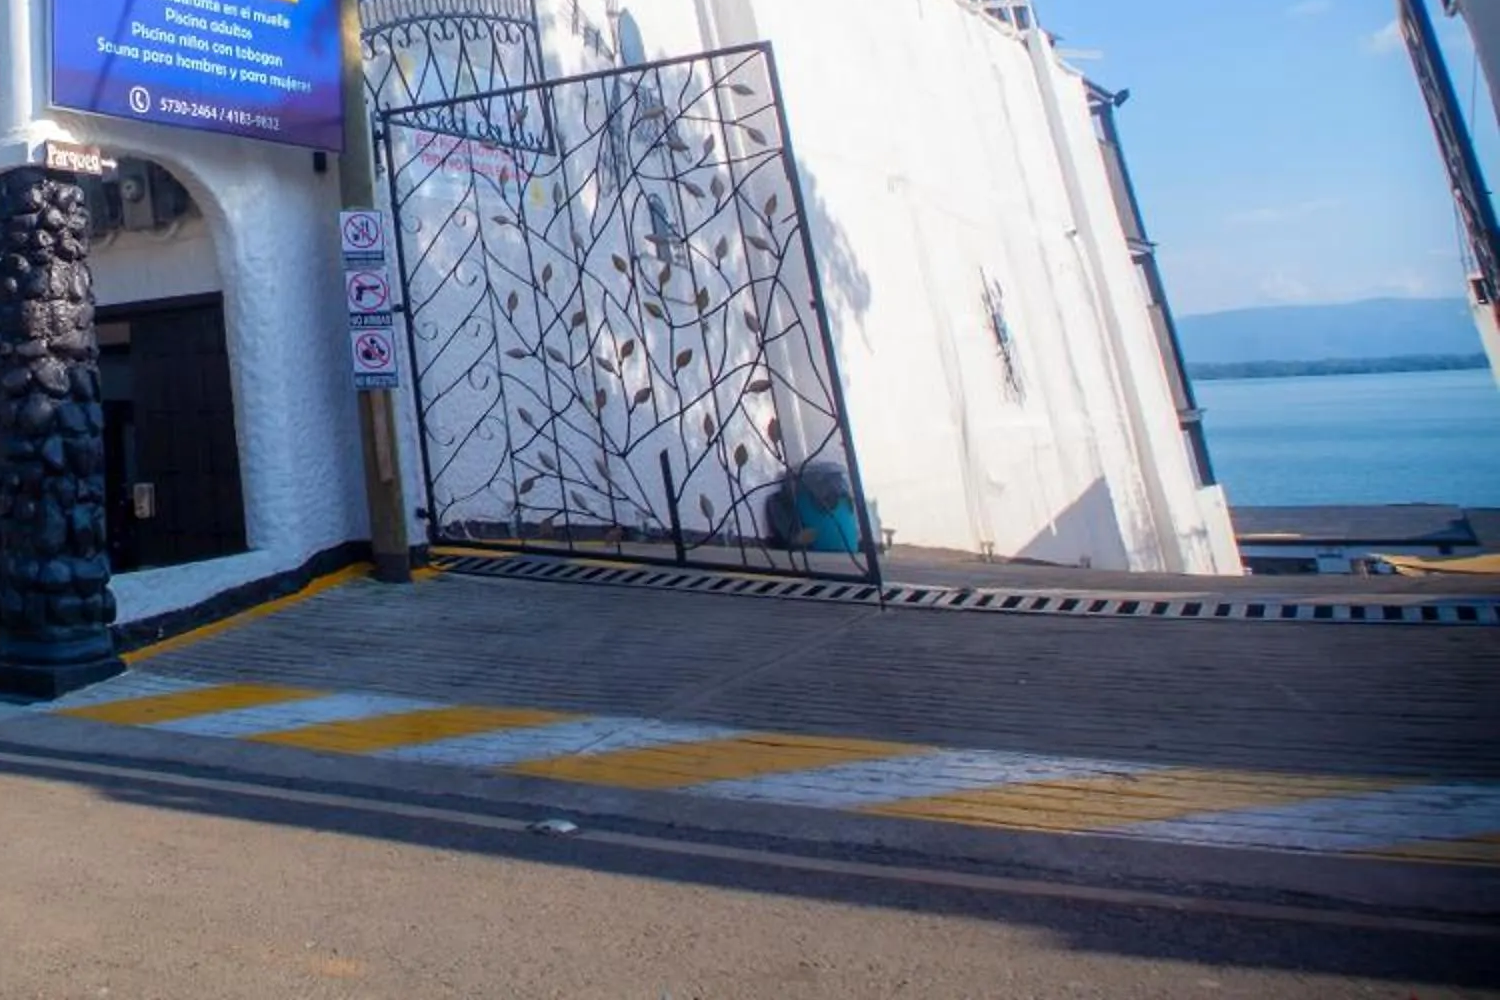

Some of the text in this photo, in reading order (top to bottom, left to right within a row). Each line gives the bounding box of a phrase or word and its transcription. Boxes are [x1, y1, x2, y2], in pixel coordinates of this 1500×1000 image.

[131, 21, 176, 44] Piscina
[212, 41, 233, 57] con
[165, 6, 253, 41] Piscina adultos
[96, 36, 139, 59] Sauna
[143, 48, 173, 66] para
[176, 51, 227, 78] hombres
[230, 67, 238, 81] y
[240, 69, 269, 87] para
[47, 143, 100, 172] Parqueo
